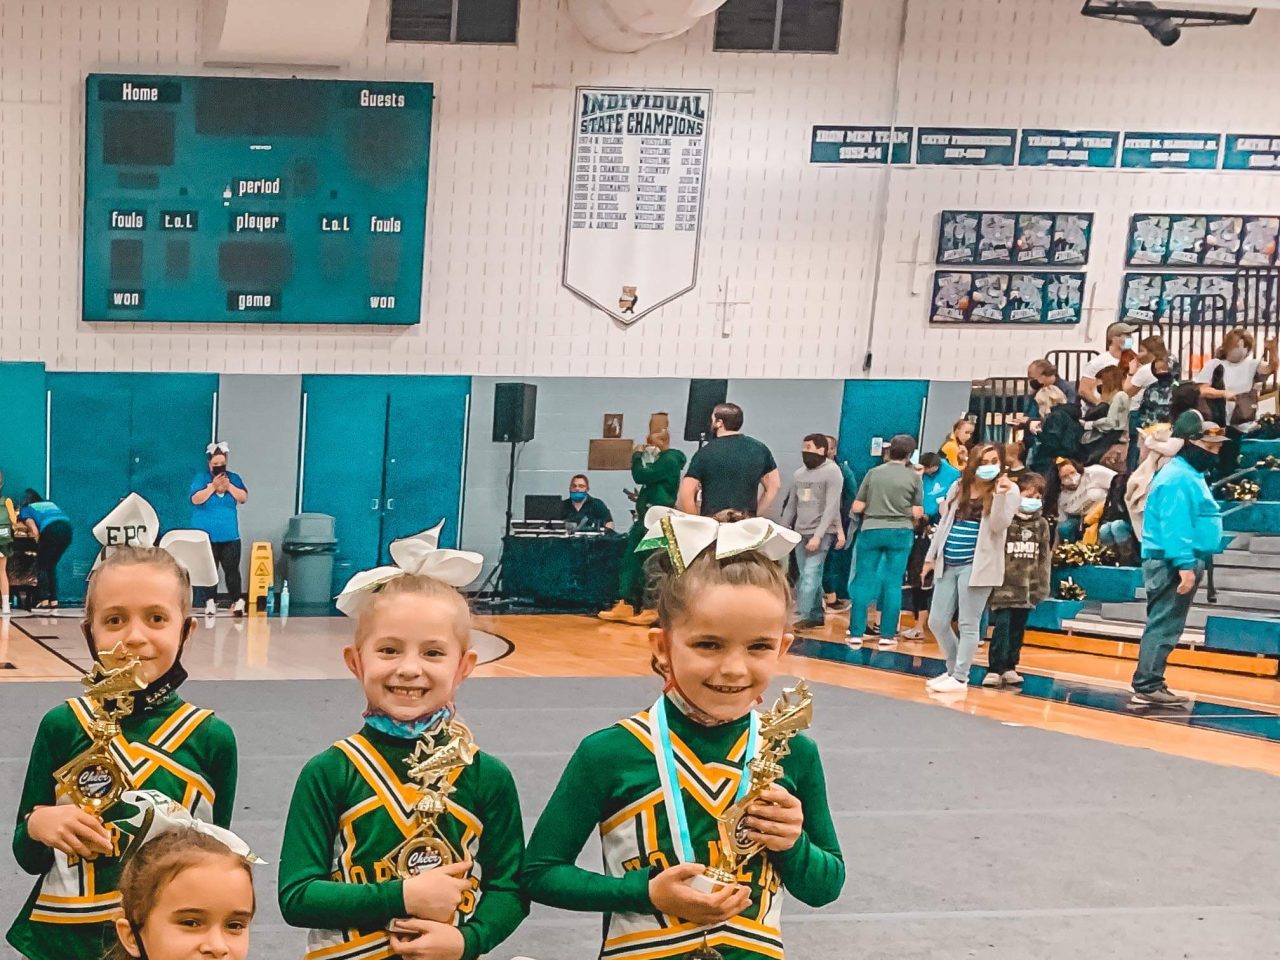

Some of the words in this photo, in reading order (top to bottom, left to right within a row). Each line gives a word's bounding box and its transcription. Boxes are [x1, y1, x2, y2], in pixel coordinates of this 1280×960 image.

[122, 82, 158, 101] Home
[360, 89, 405, 107] Guests
[581, 93, 705, 119] INDIVIDUAL
[580, 113, 623, 135] STATE
[627, 111, 703, 136] CHAMPIONS
[239, 177, 280, 194] period
[112, 211, 143, 228] fouls
[236, 211, 280, 232] player
[371, 216, 401, 232] fouls
[114, 292, 139, 305] won
[238, 294, 271, 309] game
[370, 296, 395, 309] won
[78, 770, 113, 785] Cheer
[408, 852, 442, 867] Cheer
